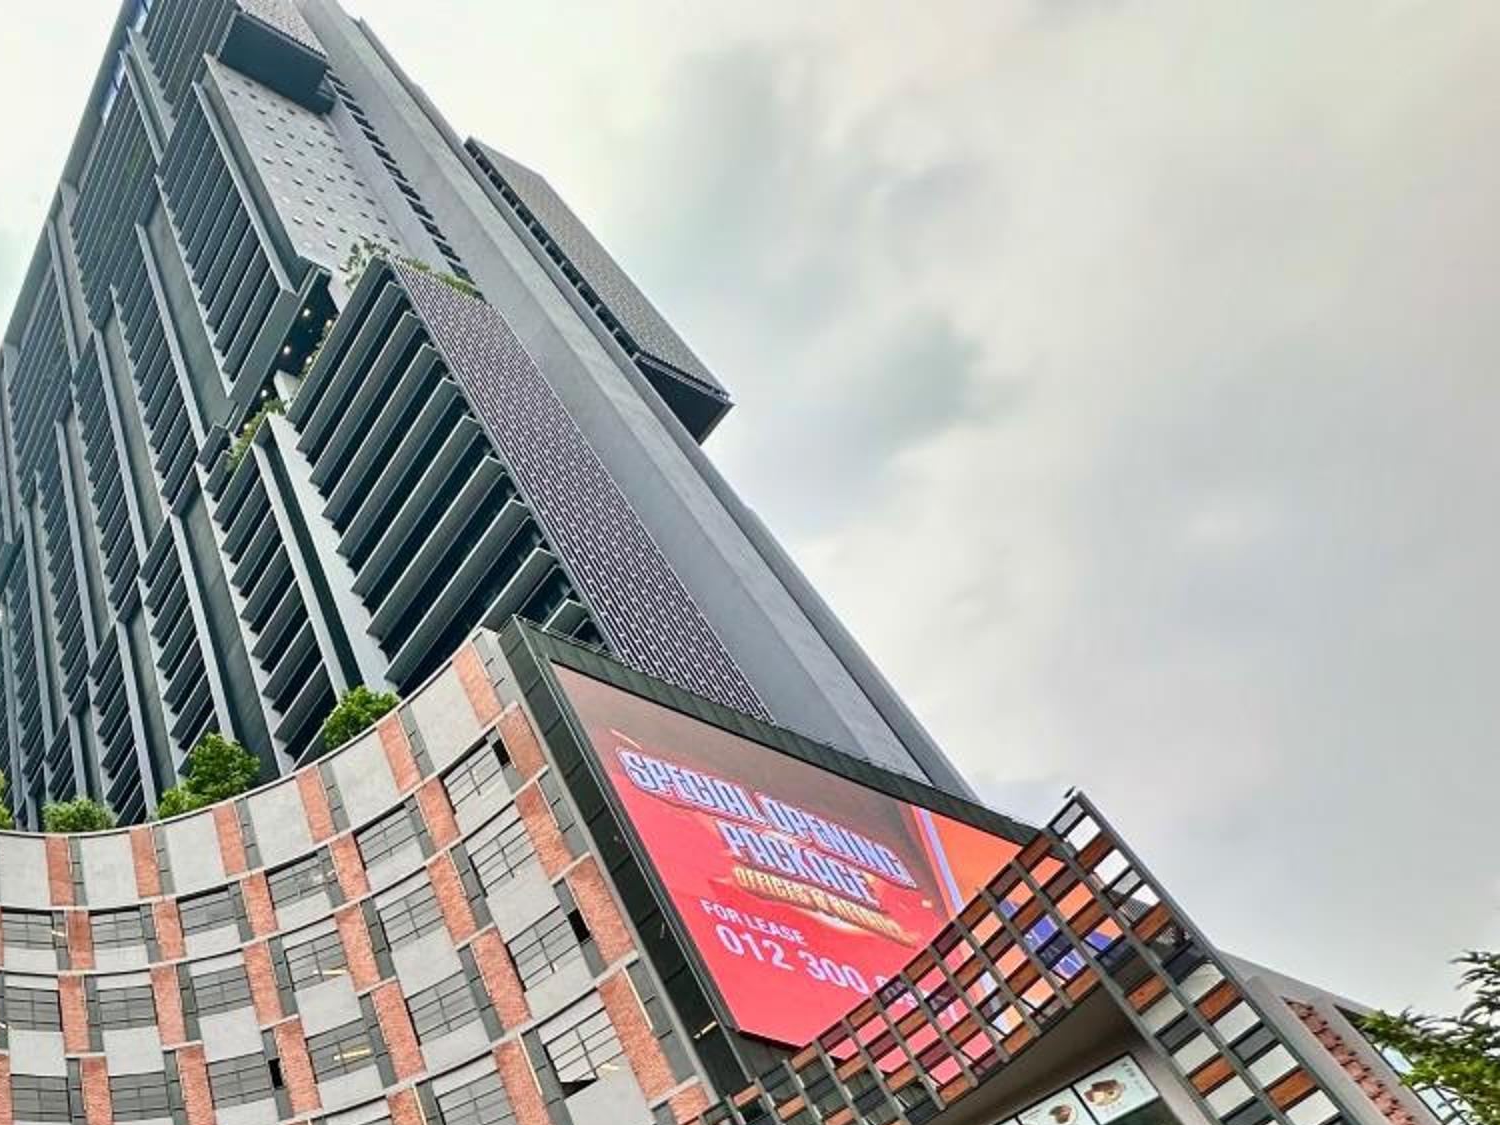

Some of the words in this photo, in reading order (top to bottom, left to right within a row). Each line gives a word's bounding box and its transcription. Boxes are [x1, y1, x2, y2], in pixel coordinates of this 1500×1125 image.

[617, 749, 773, 826] SPECIAL
[757, 794, 917, 889] OPENING
[717, 820, 881, 907] PACKAGE
[702, 900, 744, 925] FOR
[745, 914, 808, 946] LEASE
[715, 923, 796, 972] 012
[797, 949, 871, 994] 300
